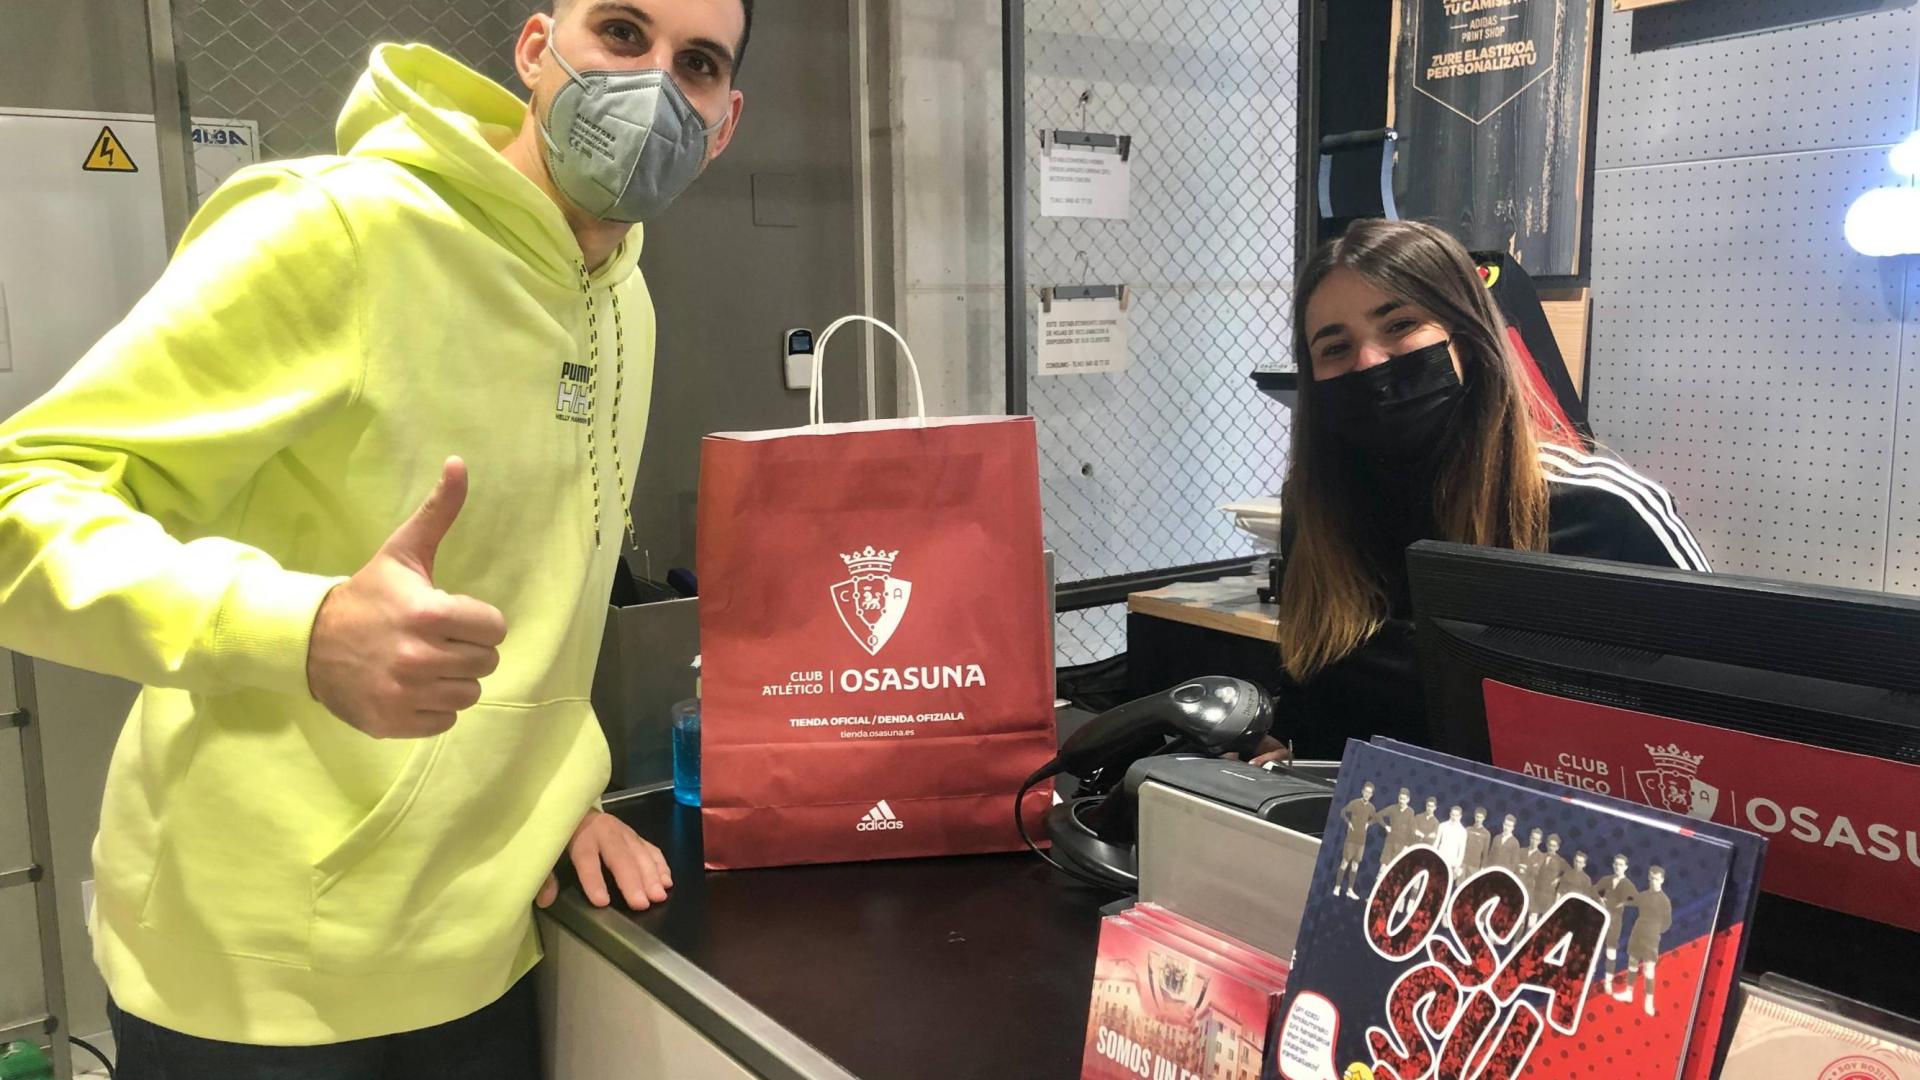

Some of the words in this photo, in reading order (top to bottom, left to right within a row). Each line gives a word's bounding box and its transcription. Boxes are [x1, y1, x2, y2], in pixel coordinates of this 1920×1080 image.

[1444, 3, 1460, 16] TU
[1469, 15, 1498, 30] ADIDAS
[1462, 30, 1483, 43] PRINT
[1484, 26, 1505, 39] SHOP
[1432, 51, 1462, 67] ZURE
[1464, 40, 1535, 62] ELASTIKOA
[1427, 52, 1537, 80] PERTSONALIZATU
[790, 671, 823, 682] CLUB
[840, 664, 986, 693] OSASUNA
[762, 681, 823, 696] ATLÉTICO
[789, 718, 829, 727] TIENDA
[830, 716, 871, 725] OFICIAL
[878, 714, 914, 724] DENDA
[917, 712, 965, 722] OFIZIALA
[840, 729, 915, 739] tienda.osasuna.es
[1558, 752, 1609, 776] CLUB
[1523, 761, 1611, 795] ATLÉTICO
[856, 819, 904, 831] adidas
[1096, 1025, 1152, 1079] SOMOS
[1153, 1054, 1178, 1080] UN
